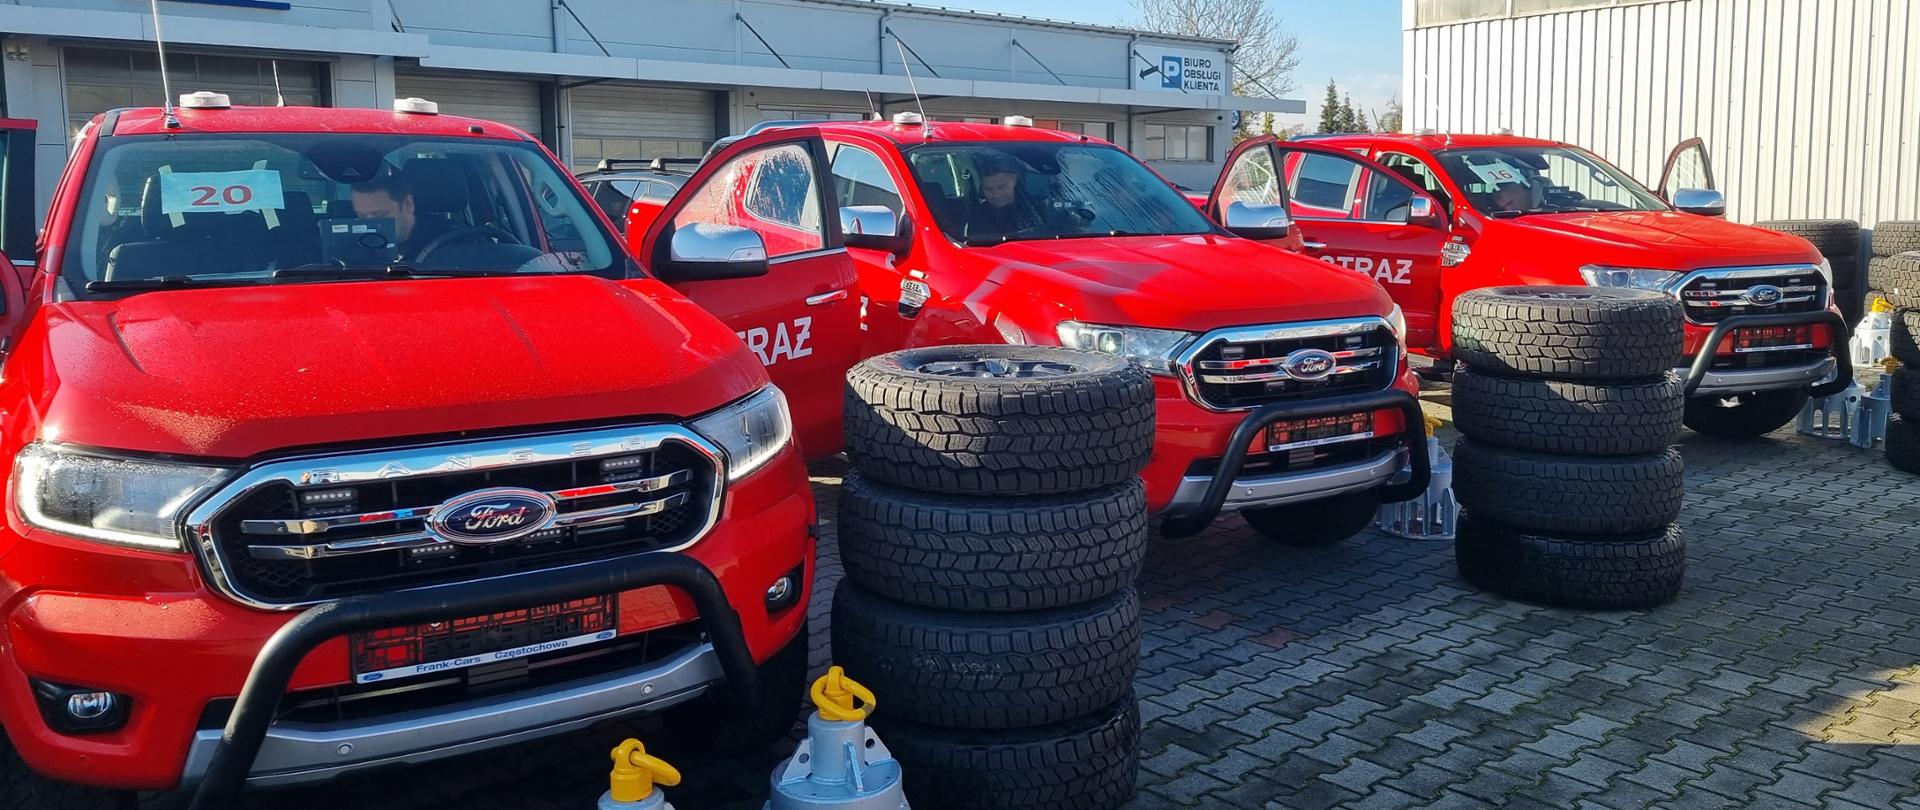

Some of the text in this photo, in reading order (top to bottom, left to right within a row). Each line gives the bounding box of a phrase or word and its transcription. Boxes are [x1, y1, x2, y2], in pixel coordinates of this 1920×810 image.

[1183, 57, 1212, 69] BIURO
[1183, 69, 1221, 81] OBSŁUGI
[1183, 80, 1220, 92] KLIENTA
[1487, 169, 1513, 180] 16
[190, 184, 253, 206] 20
[735, 315, 813, 367] RAŻ
[1301, 357, 1327, 373] Ford
[464, 502, 528, 531] Ford
[416, 639, 569, 673] Frank-Cars Częstochowa
